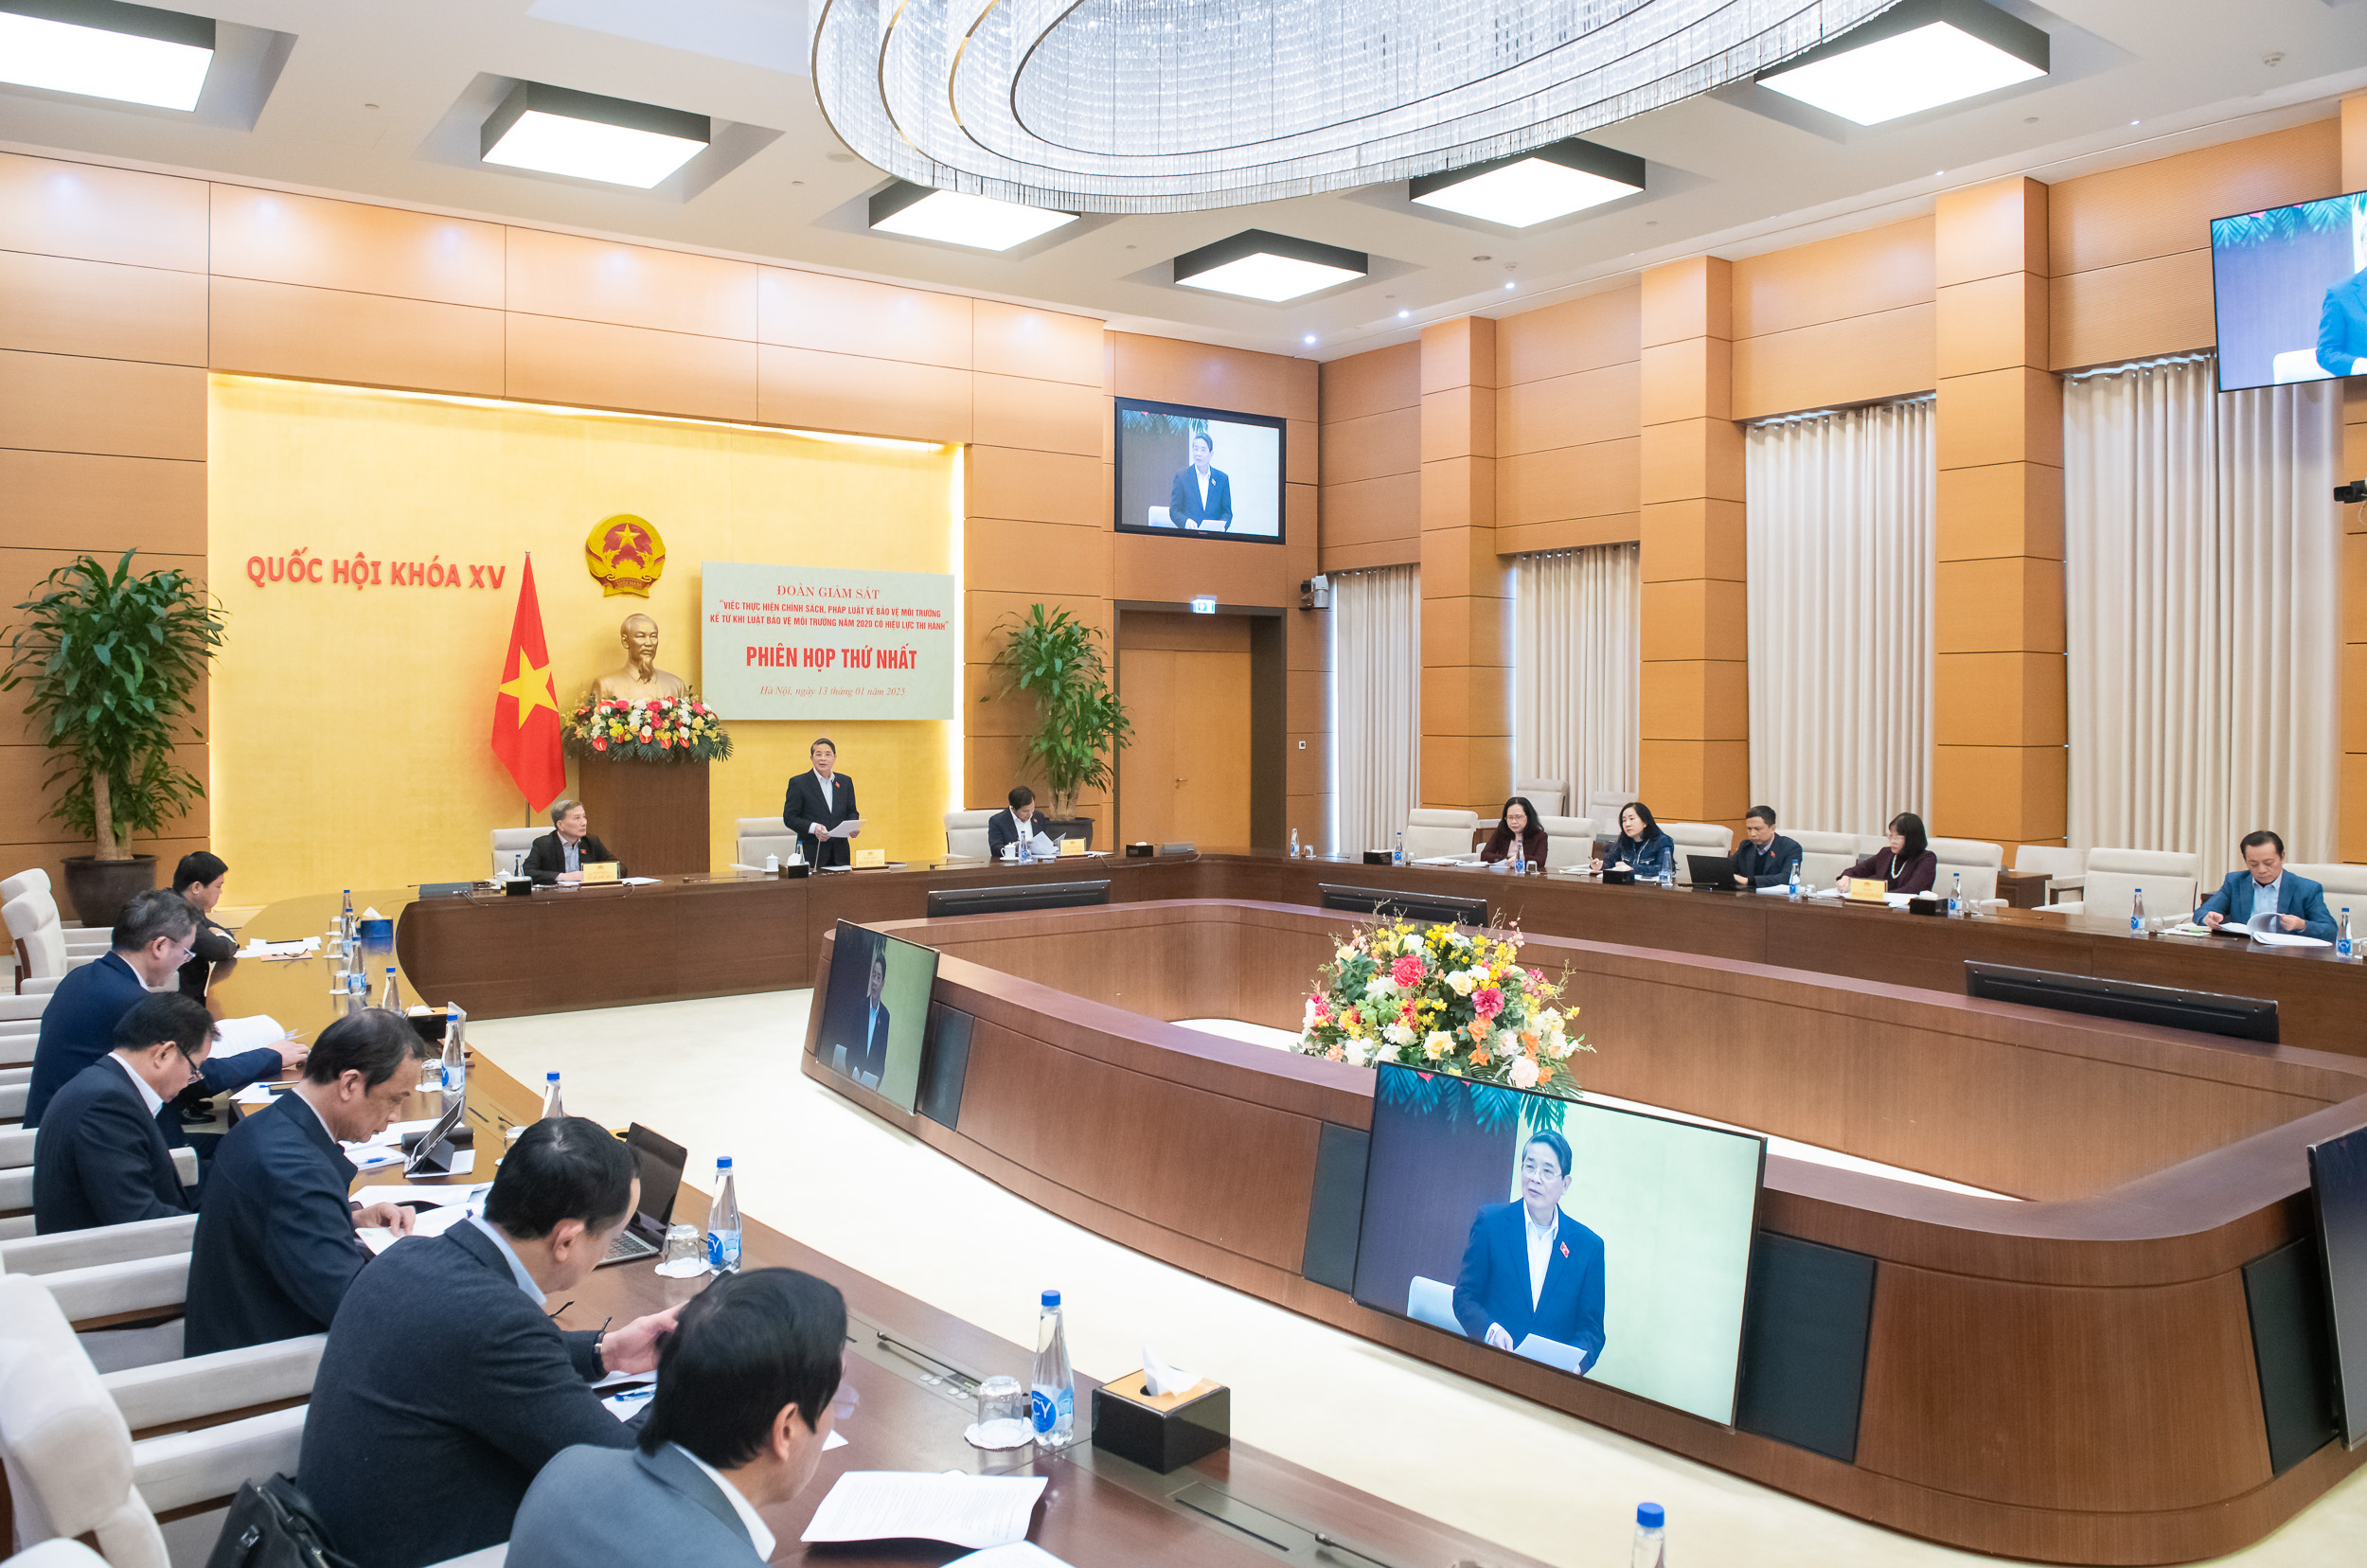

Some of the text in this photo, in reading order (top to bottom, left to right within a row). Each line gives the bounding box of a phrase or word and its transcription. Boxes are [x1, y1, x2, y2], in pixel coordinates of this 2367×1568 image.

[247, 547, 507, 591] QUỐC HỘI KHÓA XV
[776, 583, 880, 599] ĐOÀN GIÁM SÁT
[742, 601, 761, 613] THỰC
[762, 601, 780, 614] HIỆN
[781, 602, 804, 613] CHÍNH
[805, 603, 827, 614] SÁCH,
[828, 604, 846, 615] PHÁP
[847, 605, 864, 616] LUẬT
[876, 605, 890, 615] BẢO
[891, 606, 899, 617] VỆ
[901, 607, 915, 616] MÔI
[916, 607, 941, 617] TRƯỜNG
[733, 615, 745, 624] KHI
[747, 615, 765, 626] LUẬT
[766, 614, 781, 625] BẢO
[783, 615, 792, 627] VỆ
[793, 615, 808, 625] MÔI
[809, 616, 837, 627] TRƯỜNG
[838, 617, 855, 627] NĂM
[856, 619, 873, 628] 2020
[874, 619, 883, 629] CÓ
[884, 620, 900, 631] HIỆU
[901, 620, 915, 631] LỰC
[916, 621, 926, 630] THI
[746, 643, 917, 672] PHIÊN HỌP THỨ NHẤT
[760, 686, 906, 697] Hà Nội, ngày 13 tháng 01 năm 2025
[1032, 1398, 1052, 1418] CY
